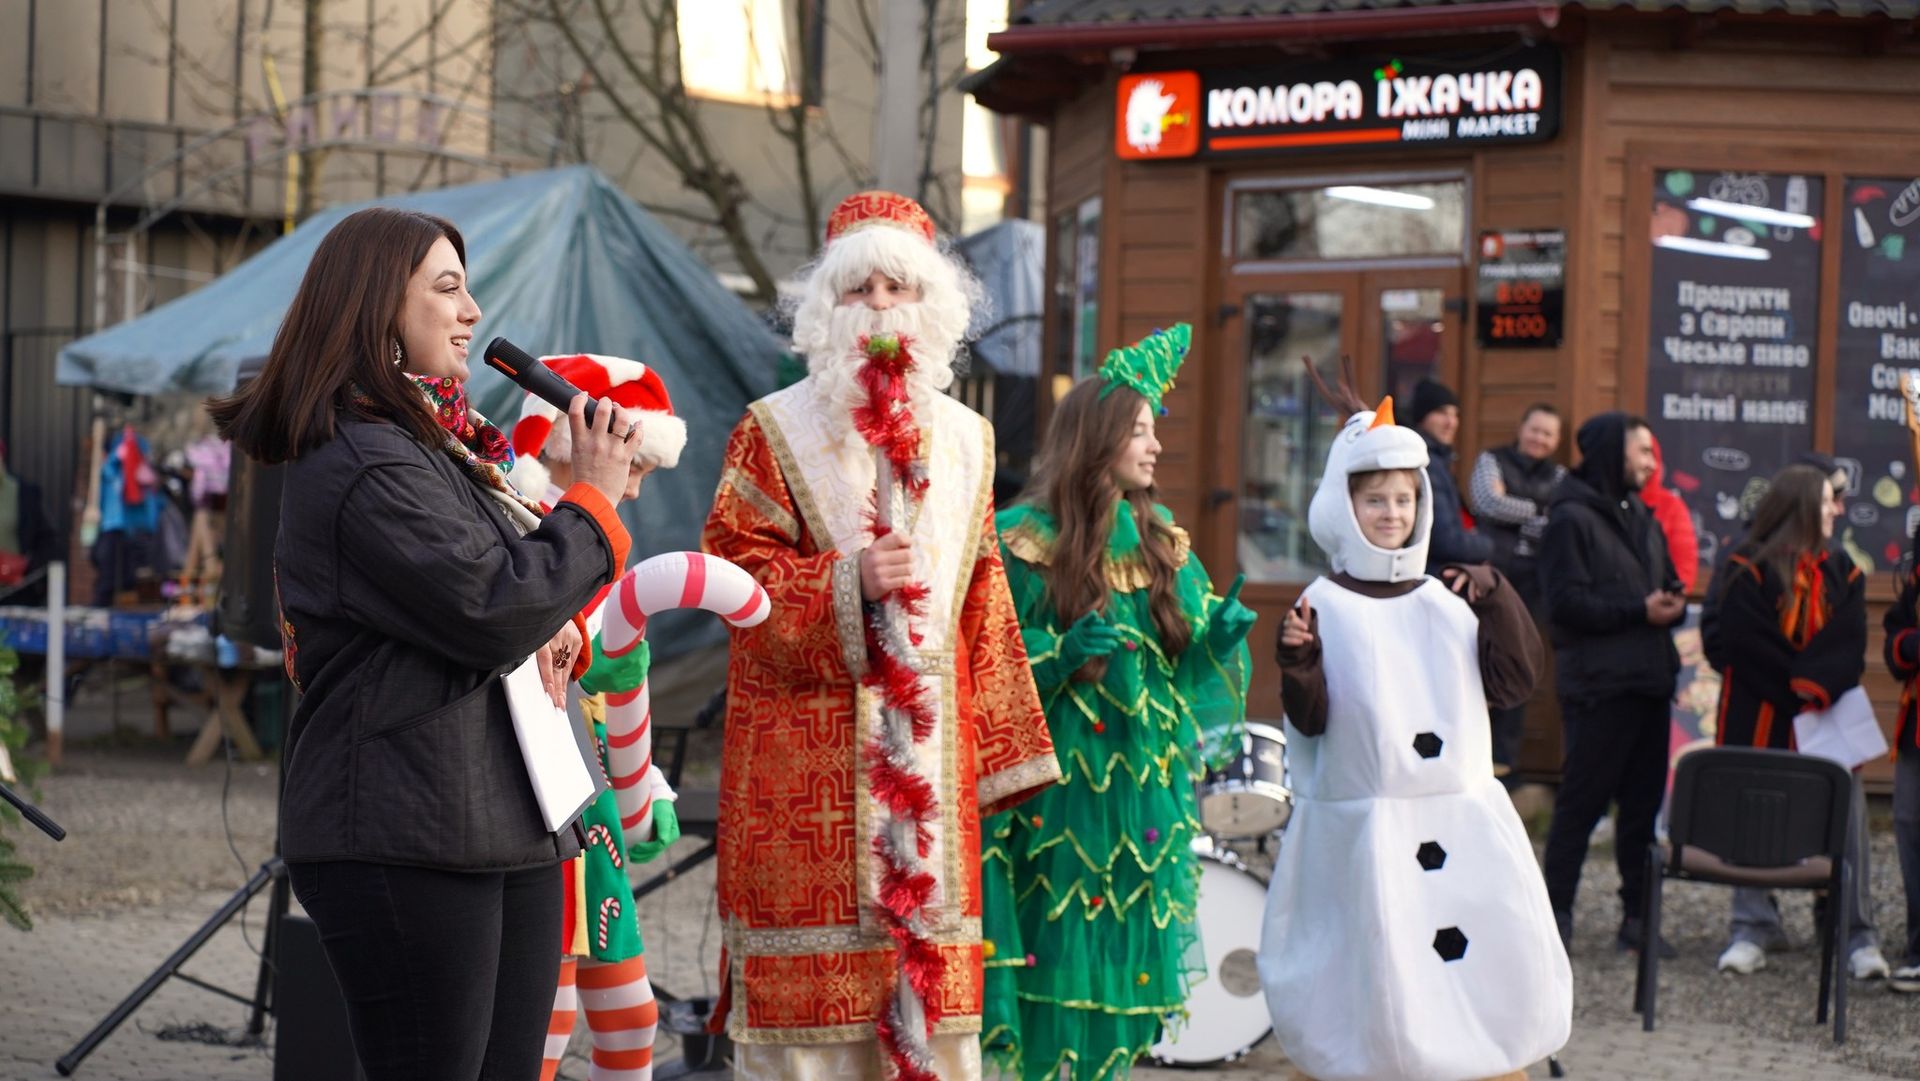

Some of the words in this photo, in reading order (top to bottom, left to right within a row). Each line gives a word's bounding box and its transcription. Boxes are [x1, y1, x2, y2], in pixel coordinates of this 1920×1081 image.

[1208, 79, 1362, 127] КОМОРА
[1402, 118, 1449, 140] МІНІ
[1457, 113, 1539, 137] МАРКЕТ
[1678, 281, 1790, 314] Продукти
[1701, 311, 1786, 342] Європи
[1848, 302, 1907, 329] Овочі
[1664, 337, 1747, 365] Чеське
[1752, 344, 1810, 368] пиво
[1663, 393, 1736, 422] Елітні
[1743, 400, 1808, 424] напої
